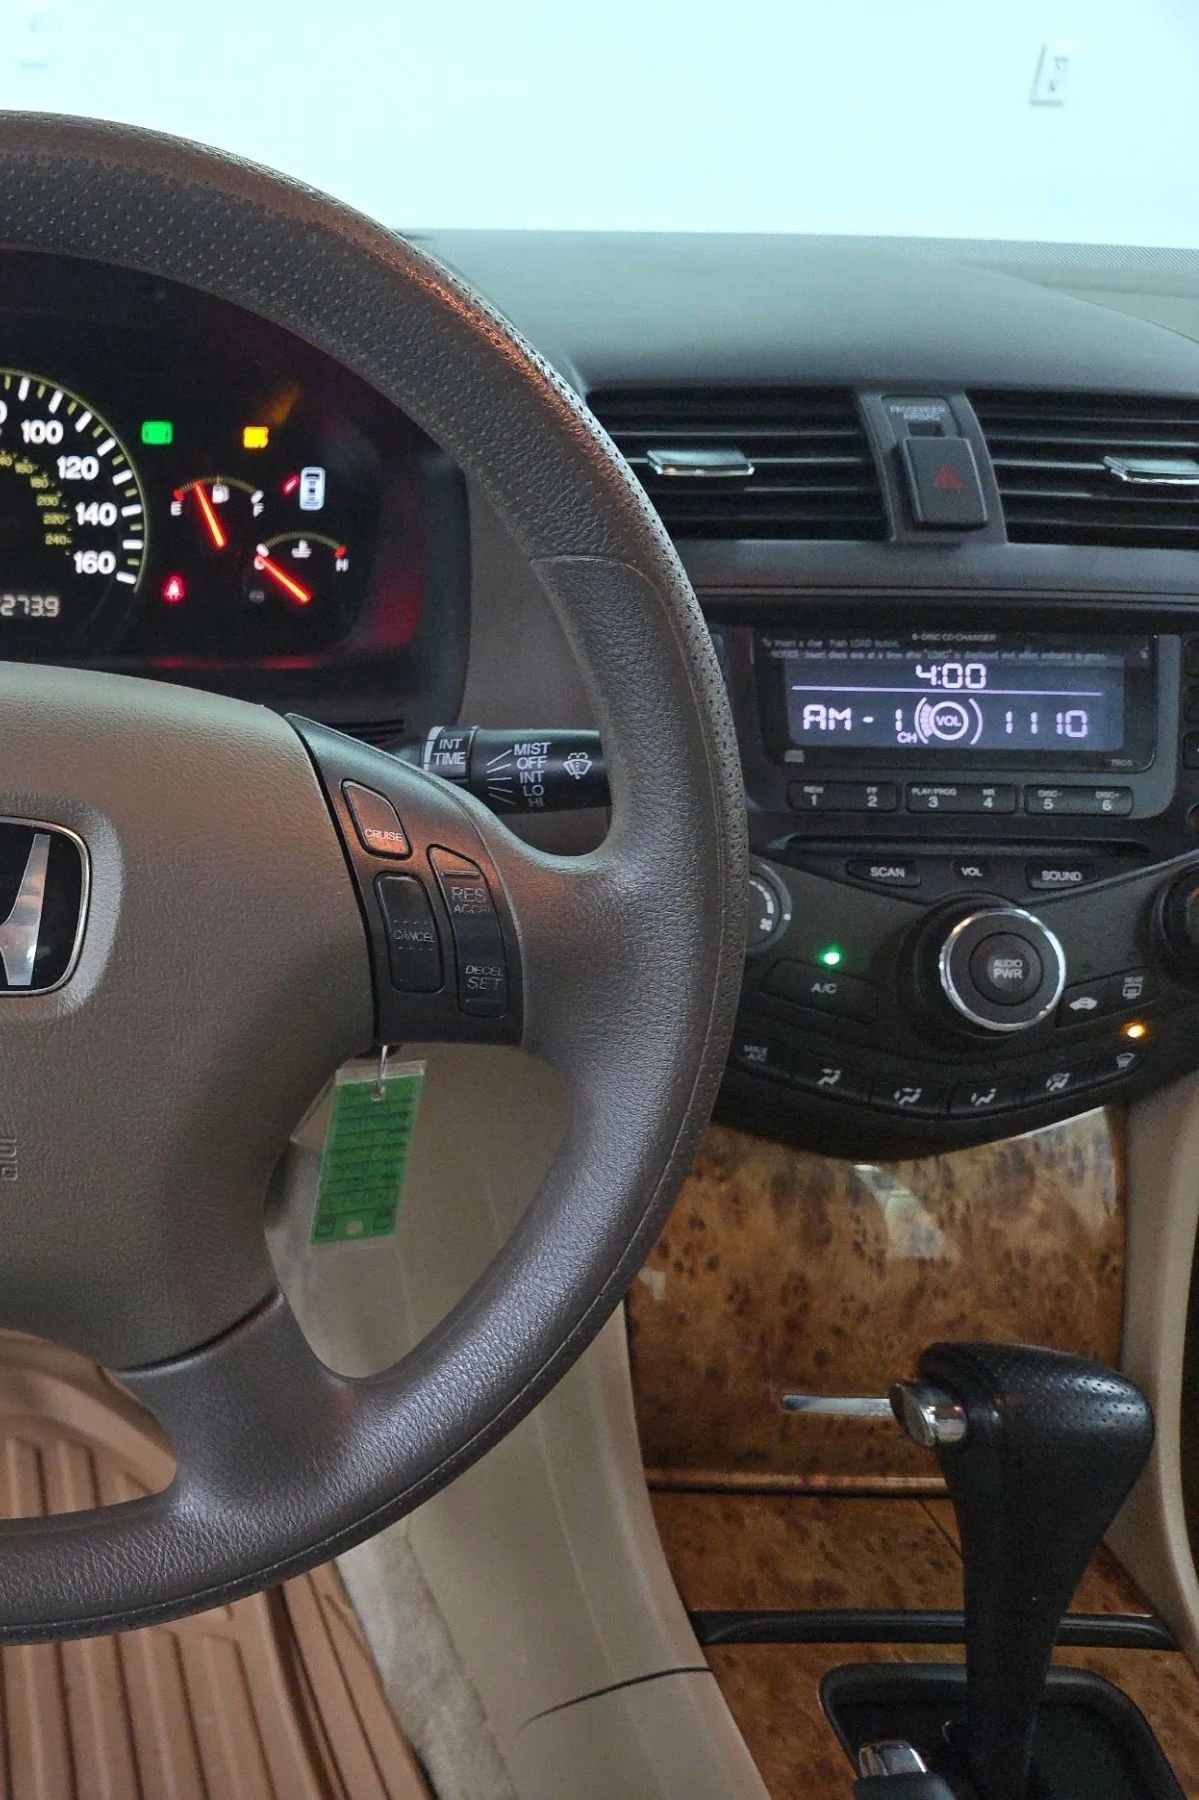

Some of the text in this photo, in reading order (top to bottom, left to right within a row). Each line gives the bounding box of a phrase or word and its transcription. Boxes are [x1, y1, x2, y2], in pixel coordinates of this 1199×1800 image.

[21, 419, 63, 445] 100
[57, 455, 99, 480] 120
[75, 501, 117, 527] 140
[170, 501, 182, 516] E
[73, 550, 116, 575] 160
[916, 663, 987, 689] 4:00
[935, 716, 962, 728] VOL
[439, 738, 462, 750] INT
[513, 742, 551, 755] MIST
[433, 752, 465, 765] TIME
[517, 756, 548, 770] OFF
[519, 770, 545, 783] INT
[523, 784, 544, 796] LO
[528, 796, 544, 807] HI
[810, 794, 818, 806] 1
[867, 795, 878, 807] 2
[928, 796, 939, 808] 3
[983, 797, 993, 808] 4
[1043, 798, 1054, 810] 5
[1102, 799, 1112, 811] 6
[364, 828, 403, 842] CRUISE
[869, 866, 905, 879] SCAN
[961, 866, 983, 878] VOL
[1041, 870, 1082, 883] SOUND
[450, 886, 486, 903] RES
[393, 929, 438, 943] CANCEL
[465, 964, 504, 976] DECEL
[993, 959, 1023, 969] AUDIO
[993, 969, 1024, 980] PWR
[467, 976, 503, 990] SET
[811, 982, 837, 995] A/C
